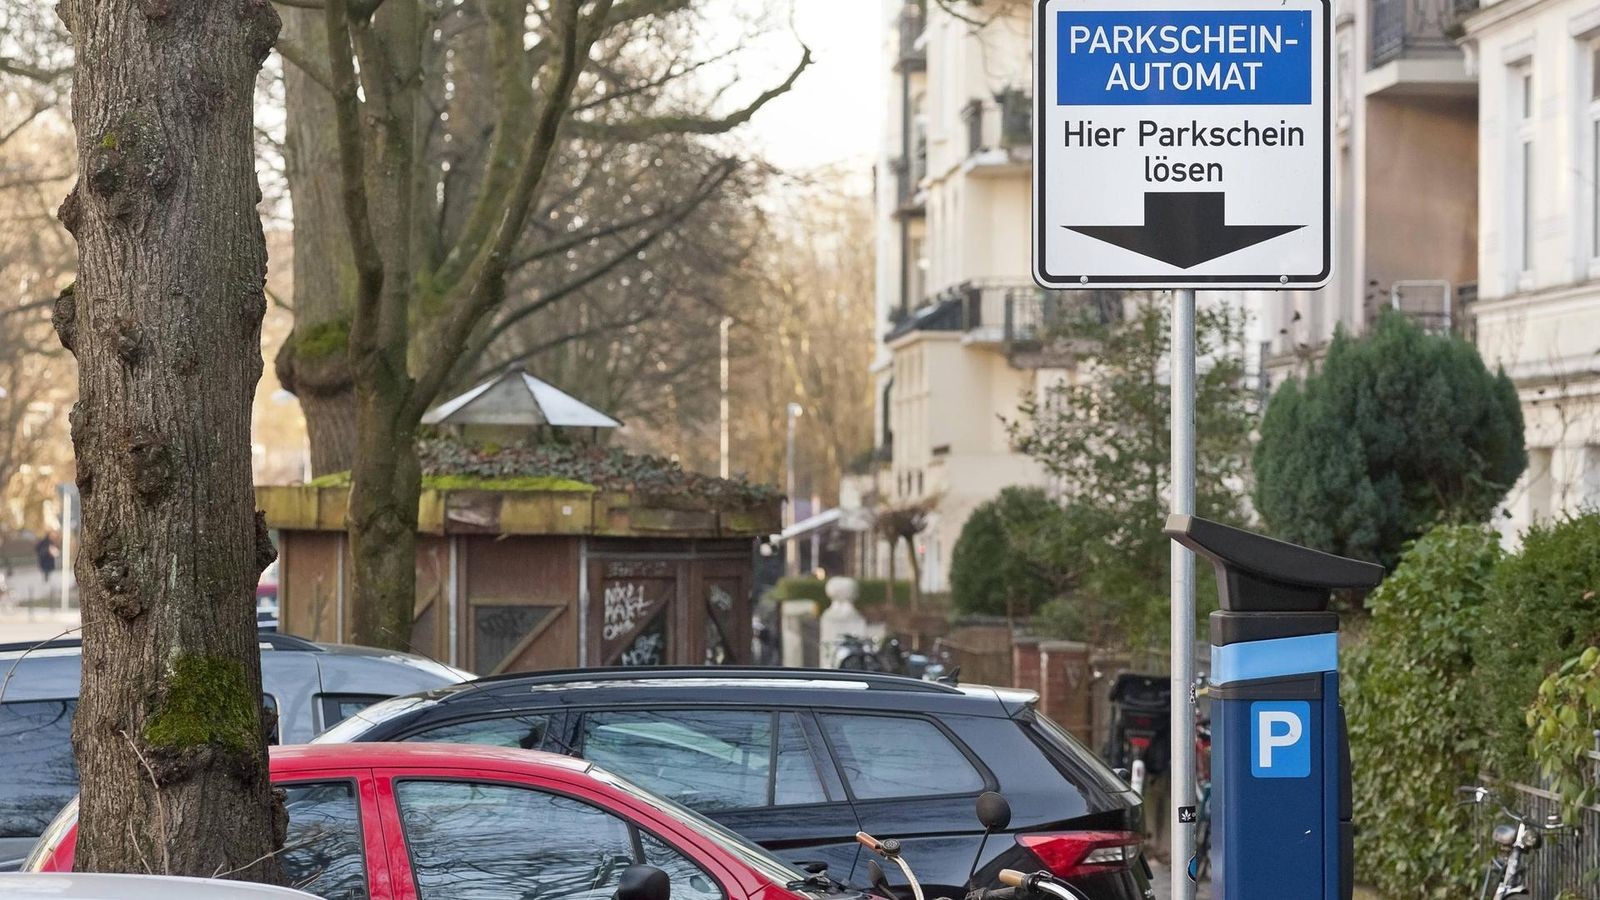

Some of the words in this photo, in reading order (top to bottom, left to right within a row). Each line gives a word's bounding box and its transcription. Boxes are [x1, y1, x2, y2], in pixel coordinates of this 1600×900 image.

[1070, 25, 1298, 54] PARKSCHEIN-
[1106, 62, 1263, 91] AUTOMAT
[1064, 120, 1126, 146] Hier
[1139, 120, 1304, 147] Parkschein
[1145, 156, 1223, 182] lösen
[1258, 711, 1303, 768] P
